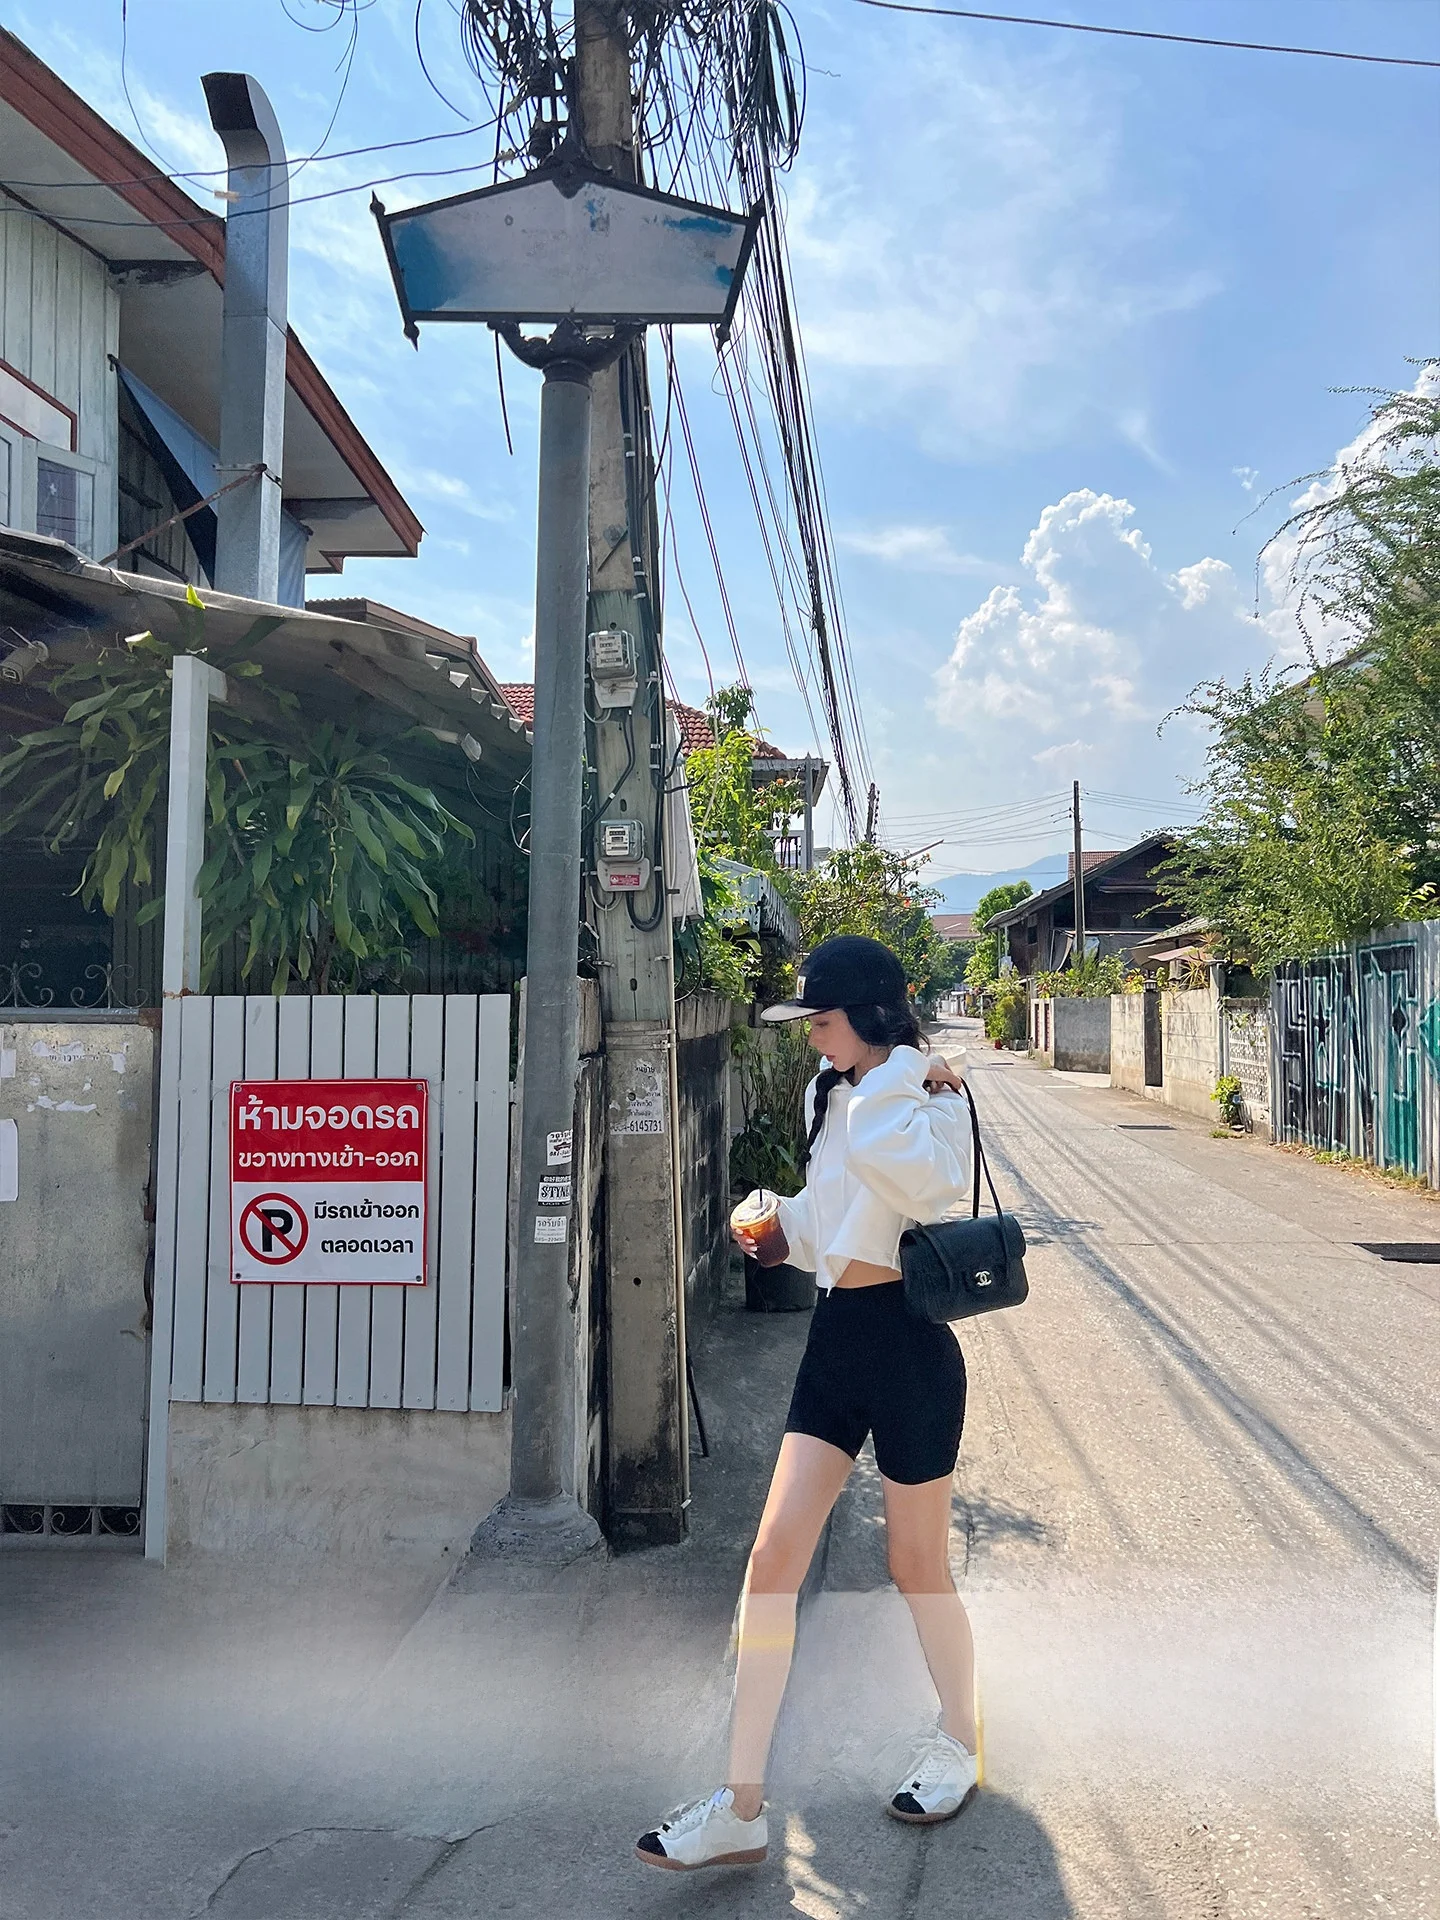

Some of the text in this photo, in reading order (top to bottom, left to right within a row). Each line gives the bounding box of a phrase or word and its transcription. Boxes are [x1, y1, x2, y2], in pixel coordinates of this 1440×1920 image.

[238, 1095, 419, 1130] ห้ามจอดรถ
[238, 1145, 419, 1168] ขวางทางเข้า-ออก
[314, 1199, 420, 1219] มีรถเข้าออก
[320, 1239, 414, 1254] ตลอดเวลา
